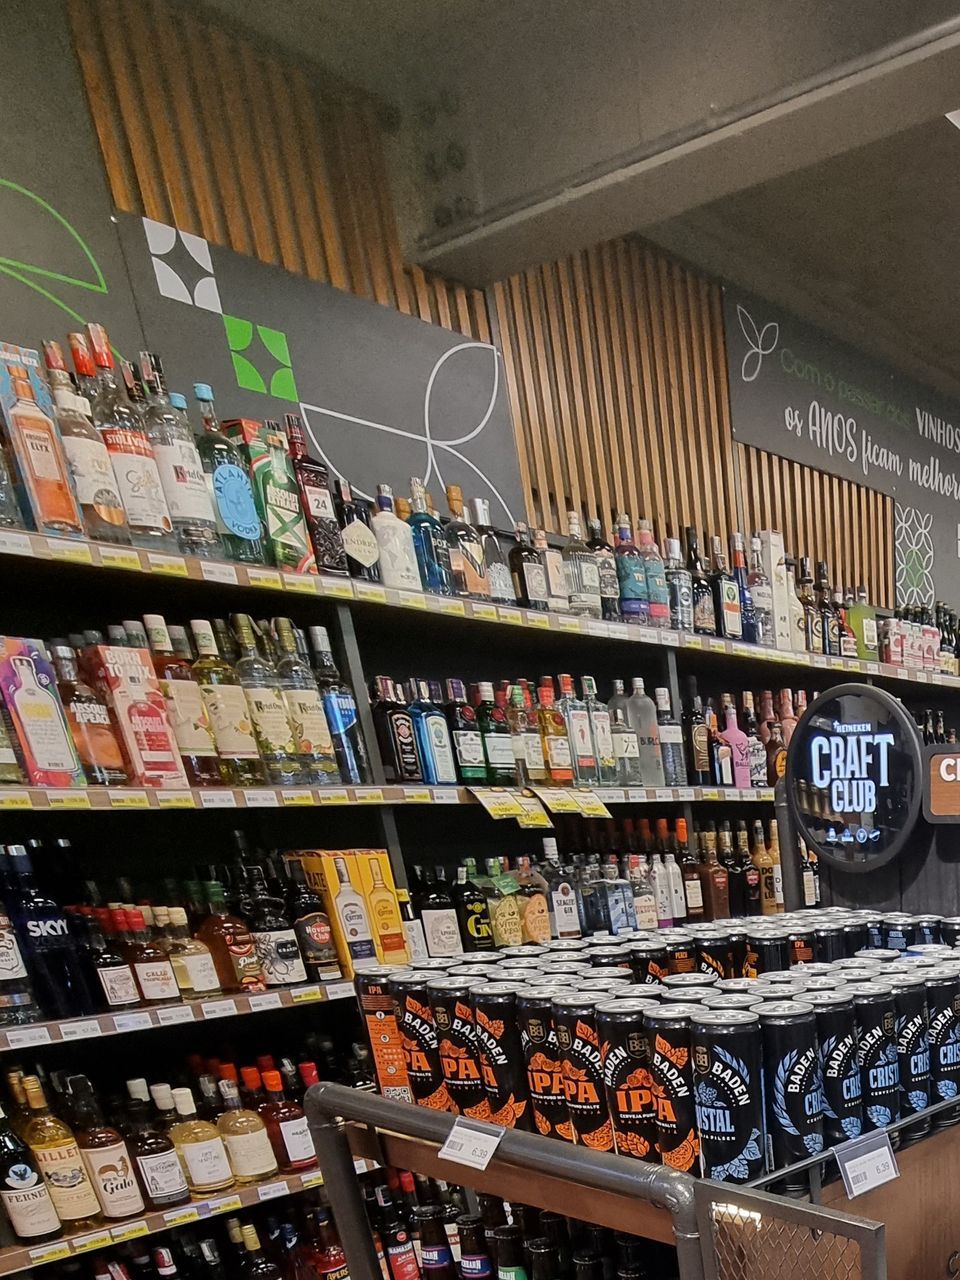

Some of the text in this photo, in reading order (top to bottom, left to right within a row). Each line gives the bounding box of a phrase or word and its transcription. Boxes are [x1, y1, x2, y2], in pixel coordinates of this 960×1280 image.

[784, 405, 803, 438] os
[807, 400, 858, 463] ANOS
[861, 429, 904, 477] ficam
[314, 498, 328, 510] 24
[836, 722, 871, 733] HEINEKEN
[810, 733, 895, 788] CRAFT
[831, 779, 877, 814] CLUB
[27, 918, 69, 938] SKYY
[368, 986, 382, 995] IPA
[404, 1012, 439, 1050] BADEN
[897, 1014, 923, 1054] BADEN
[928, 1006, 954, 1045] BADEN
[476, 1025, 508, 1066] BADEN
[827, 1034, 854, 1078] BADEN
[605, 1045, 628, 1087] BADEN
[653, 1053, 690, 1098] BADEN
[712, 1061, 750, 1106] BADEN
[788, 1047, 816, 1093] BADEN
[36, 1146, 79, 1162] LILLET
[7, 1189, 48, 1203] FERNET
[103, 1180, 134, 1195] Galo
